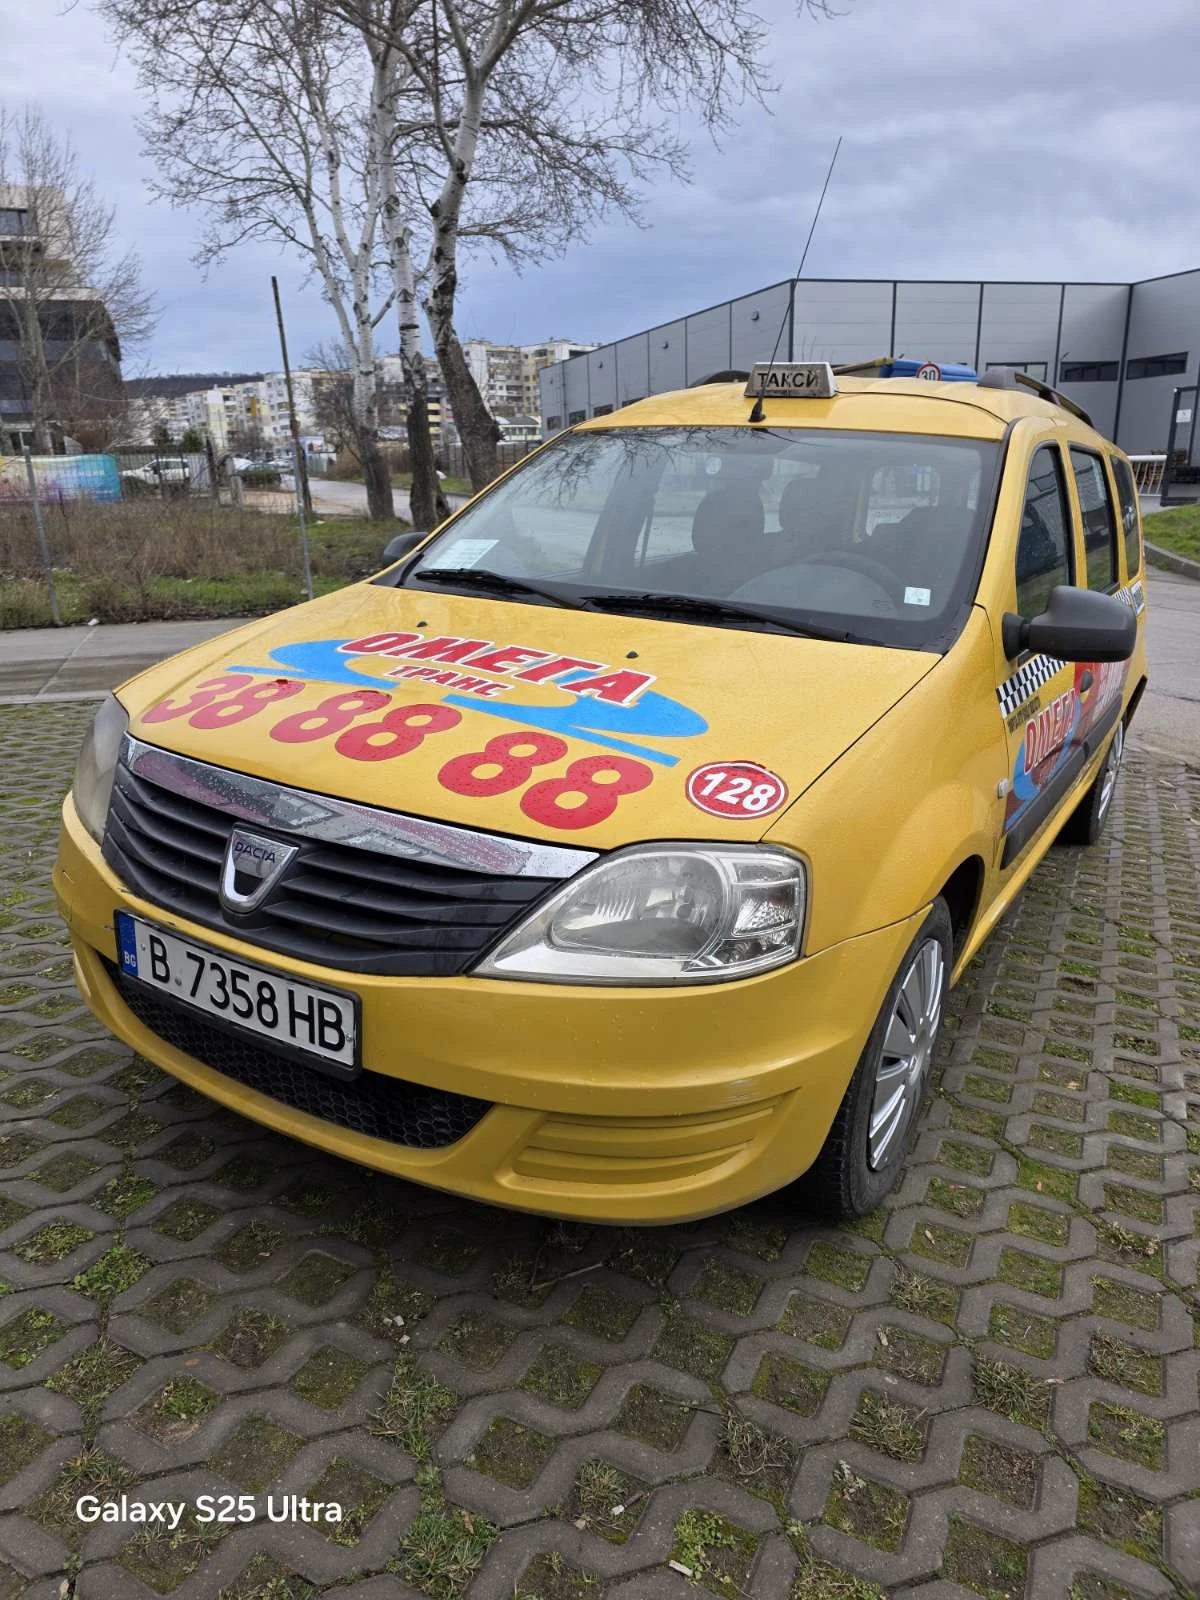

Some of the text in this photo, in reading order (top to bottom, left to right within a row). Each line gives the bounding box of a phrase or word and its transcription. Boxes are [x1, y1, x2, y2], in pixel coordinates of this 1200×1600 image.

[337, 632, 657, 708] ОМЕГА
[384, 665, 515, 698] ТРАНС
[700, 772, 776, 811] 128
[234, 842, 276, 863] DACIA
[124, 951, 137, 966] BG
[186, 953, 279, 1029] 7358
